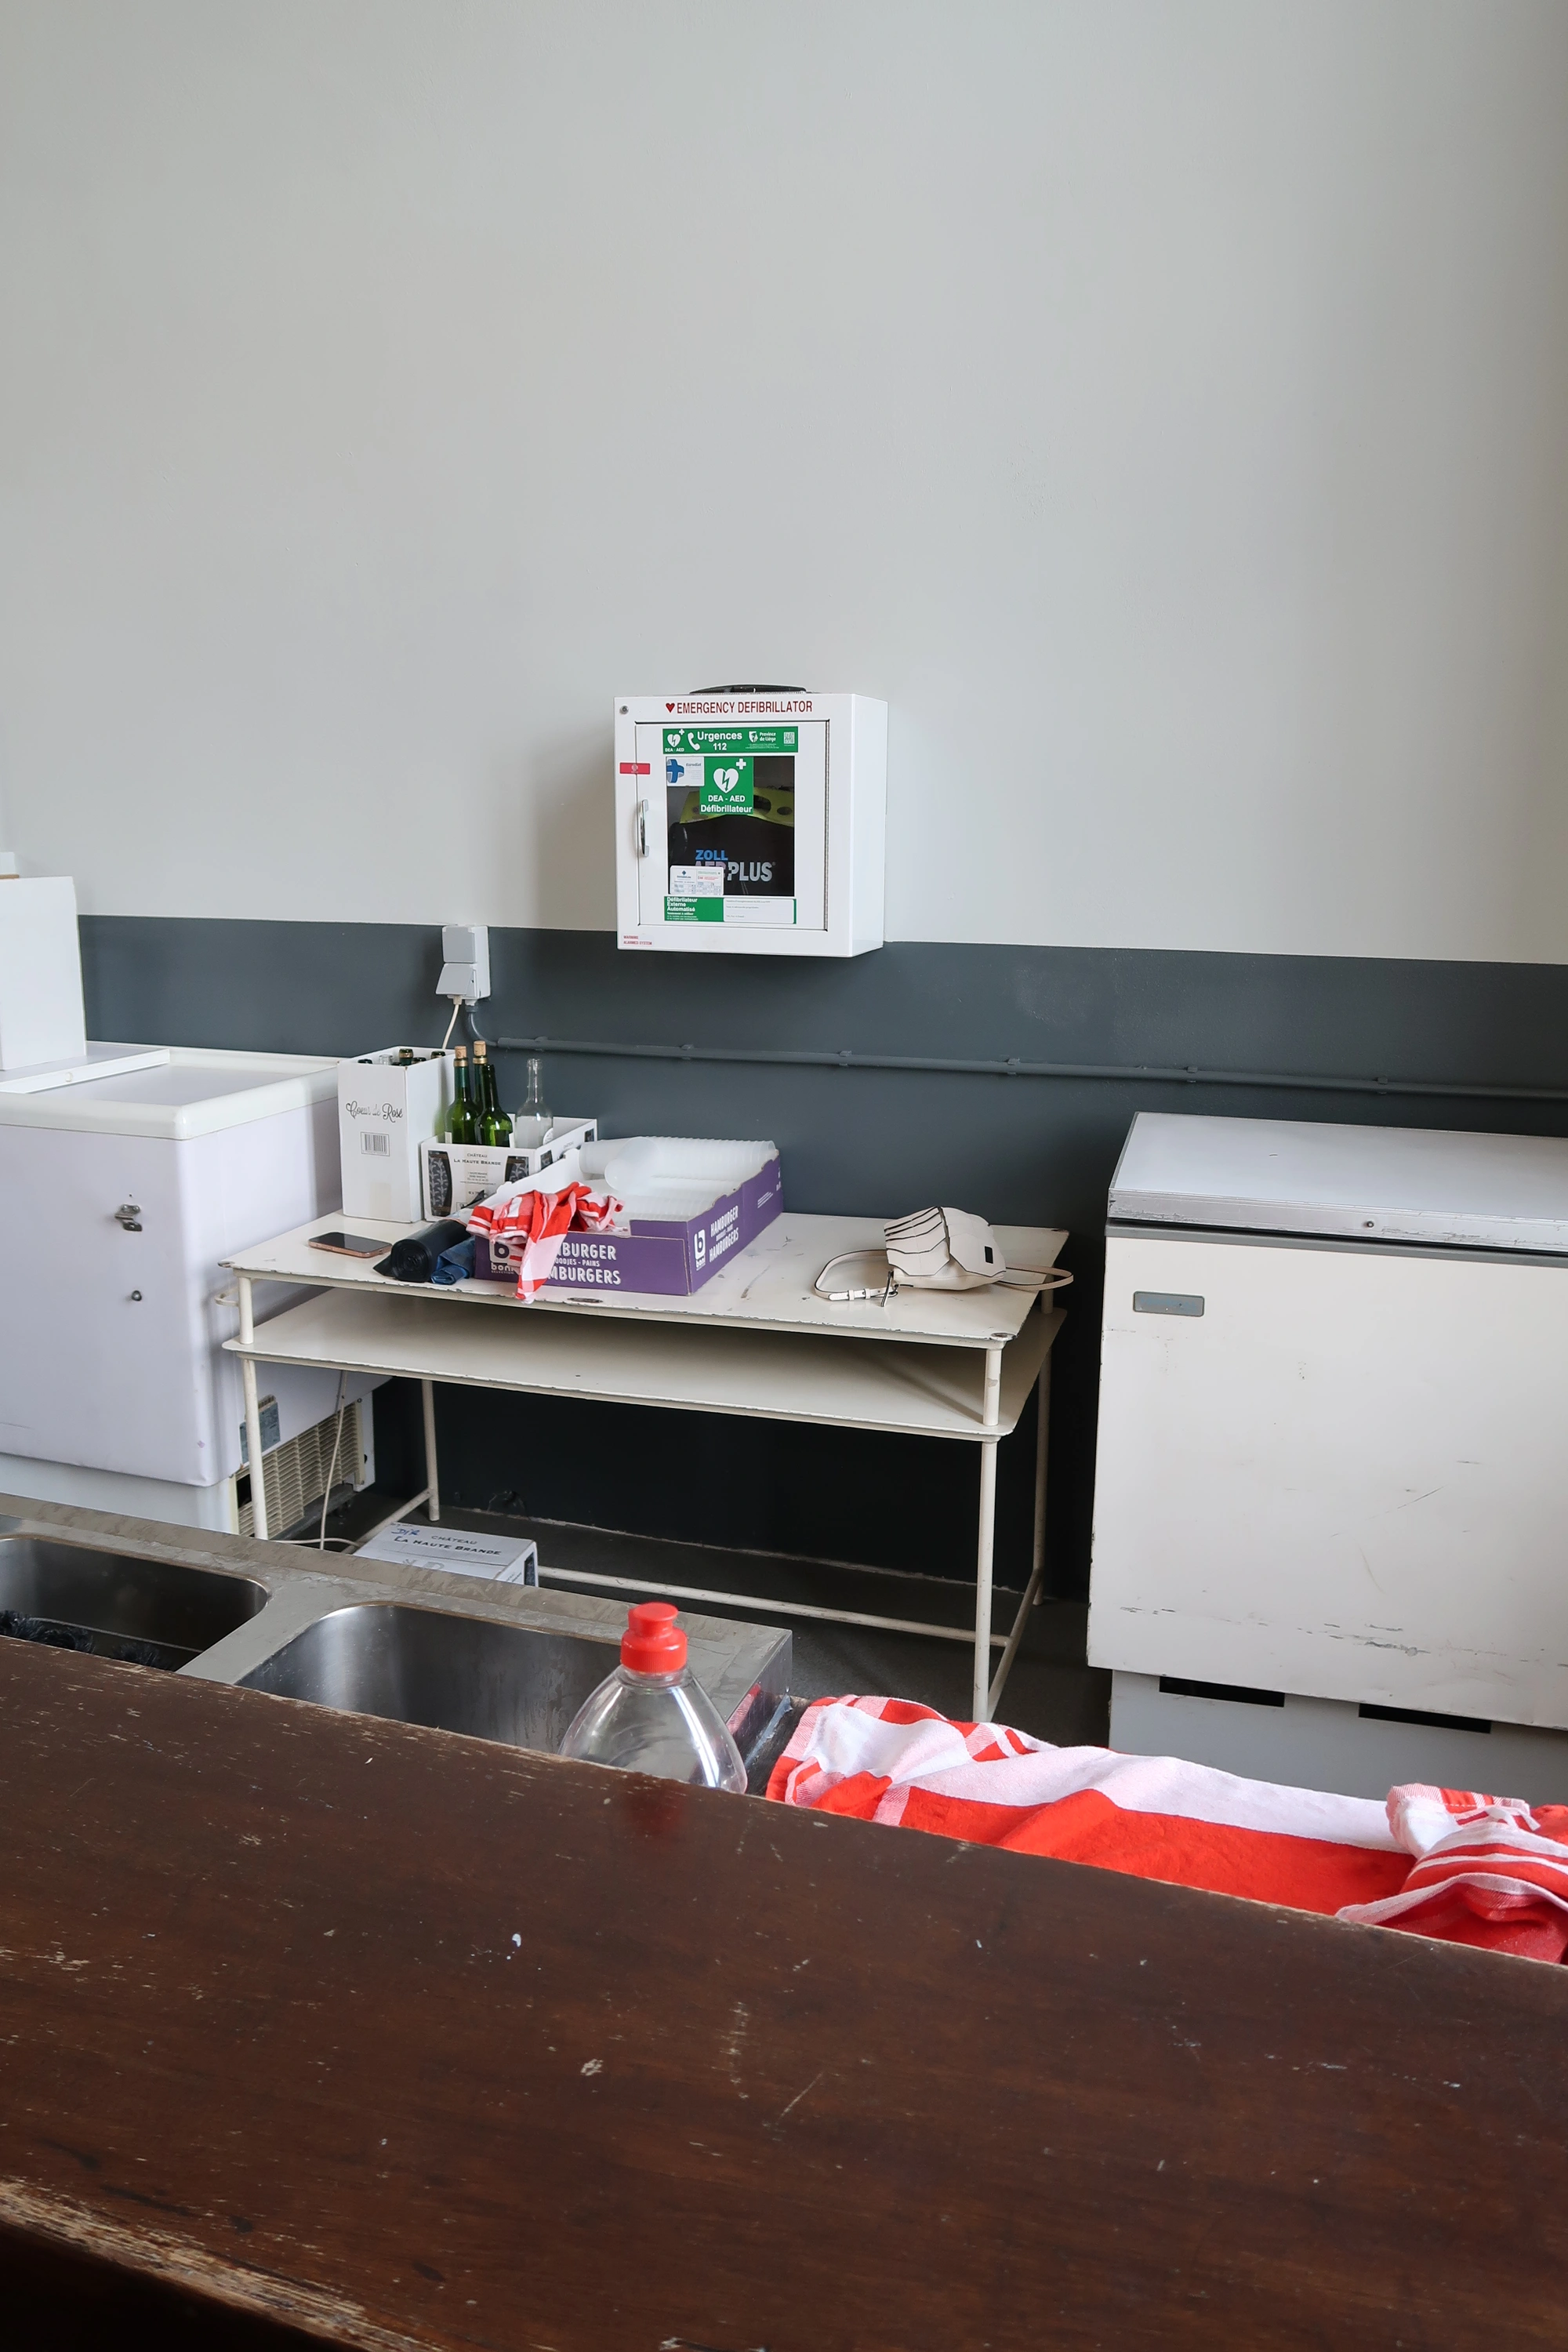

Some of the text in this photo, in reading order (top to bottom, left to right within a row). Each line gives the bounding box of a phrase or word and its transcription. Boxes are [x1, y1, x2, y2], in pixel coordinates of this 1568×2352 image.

[677, 700, 813, 714] EMERGENCY DEFIBRILLATOR
[697, 731, 742, 742] Urgences
[713, 742, 727, 751] 112
[700, 804, 753, 813] Défibrillateur
[695, 849, 728, 861] ZOLL
[727, 862, 772, 882] PLUS
[710, 1205, 739, 1238] HAMBURGER
[557, 1242, 617, 1261] BURGER
[709, 1227, 739, 1263] HAMBURGERS
[548, 1265, 621, 1285] MBURGERS
[431, 1535, 477, 1545] CHÂTEAU
[412, 1540, 452, 1549] HAUTE
[455, 1545, 502, 1555] BRANDE
